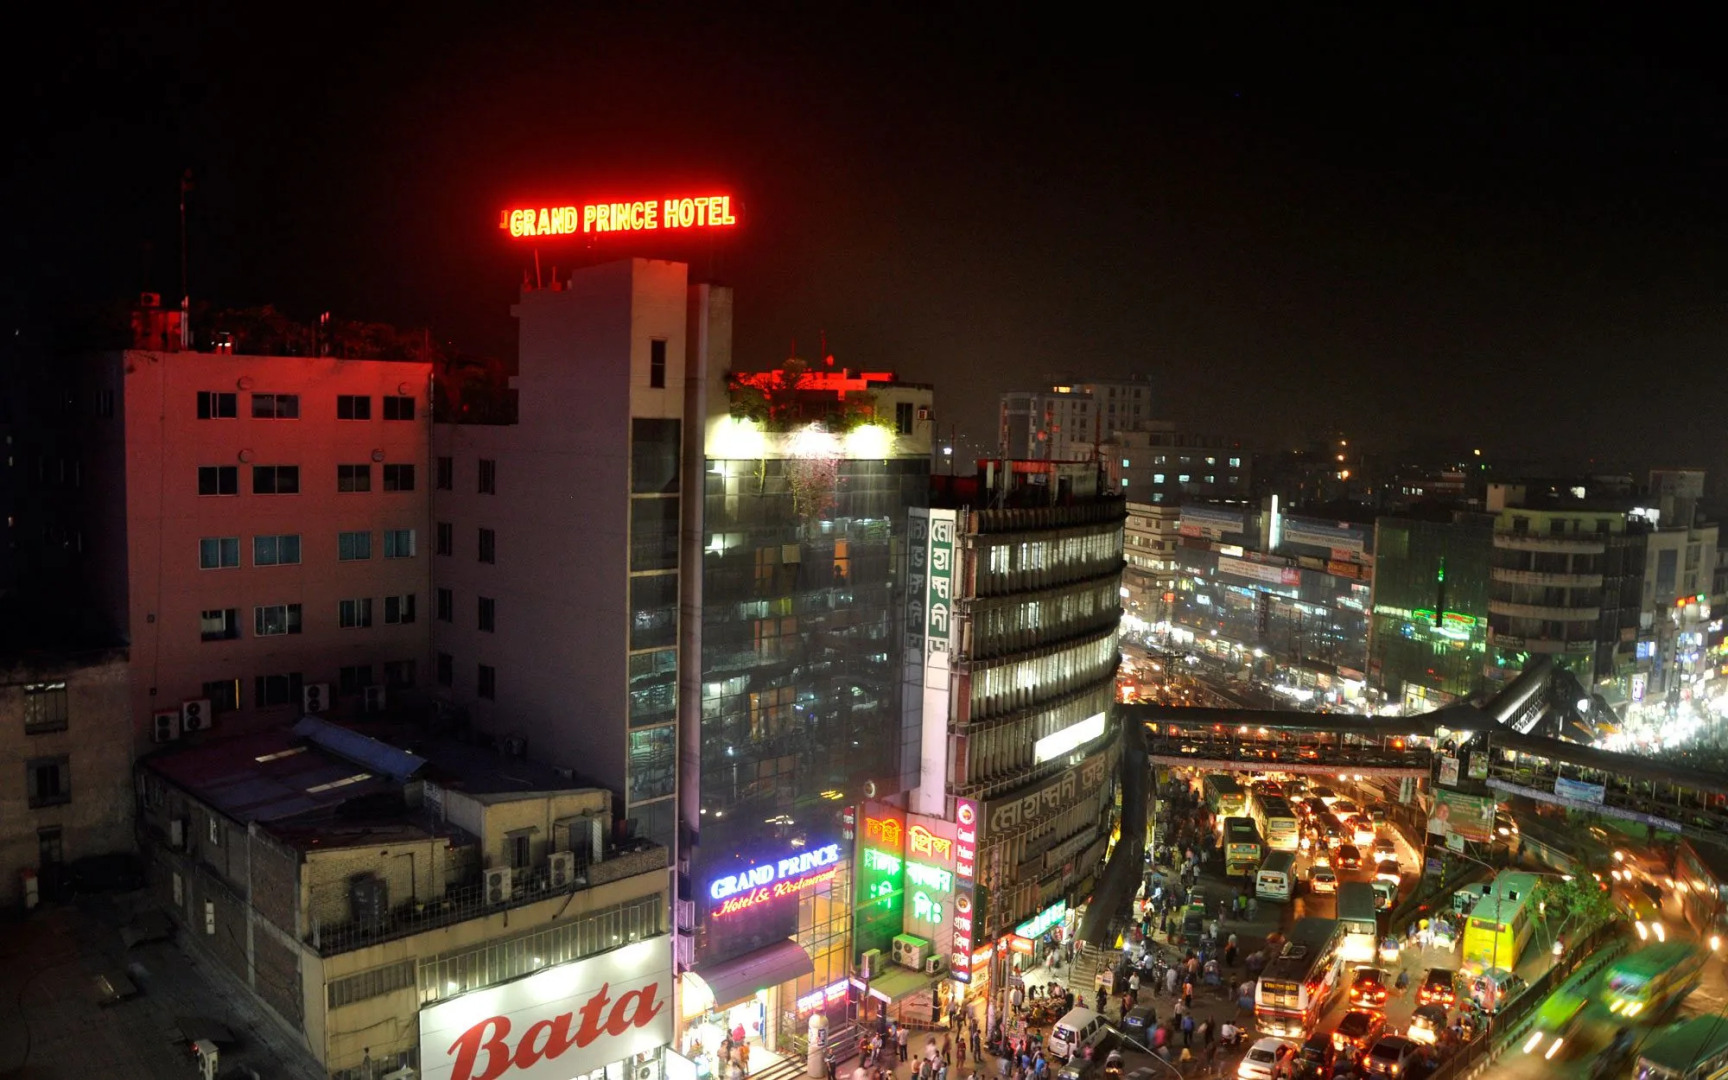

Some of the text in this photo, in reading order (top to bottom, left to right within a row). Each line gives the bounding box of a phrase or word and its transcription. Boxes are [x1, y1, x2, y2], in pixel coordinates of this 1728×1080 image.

[510, 196, 736, 237] GRAND PRINCE HOTEL
[710, 844, 838, 899] GRAND PRINCE
[712, 888, 757, 917] Hotel
[755, 888, 769, 903] &
[447, 982, 664, 1080] Bata
